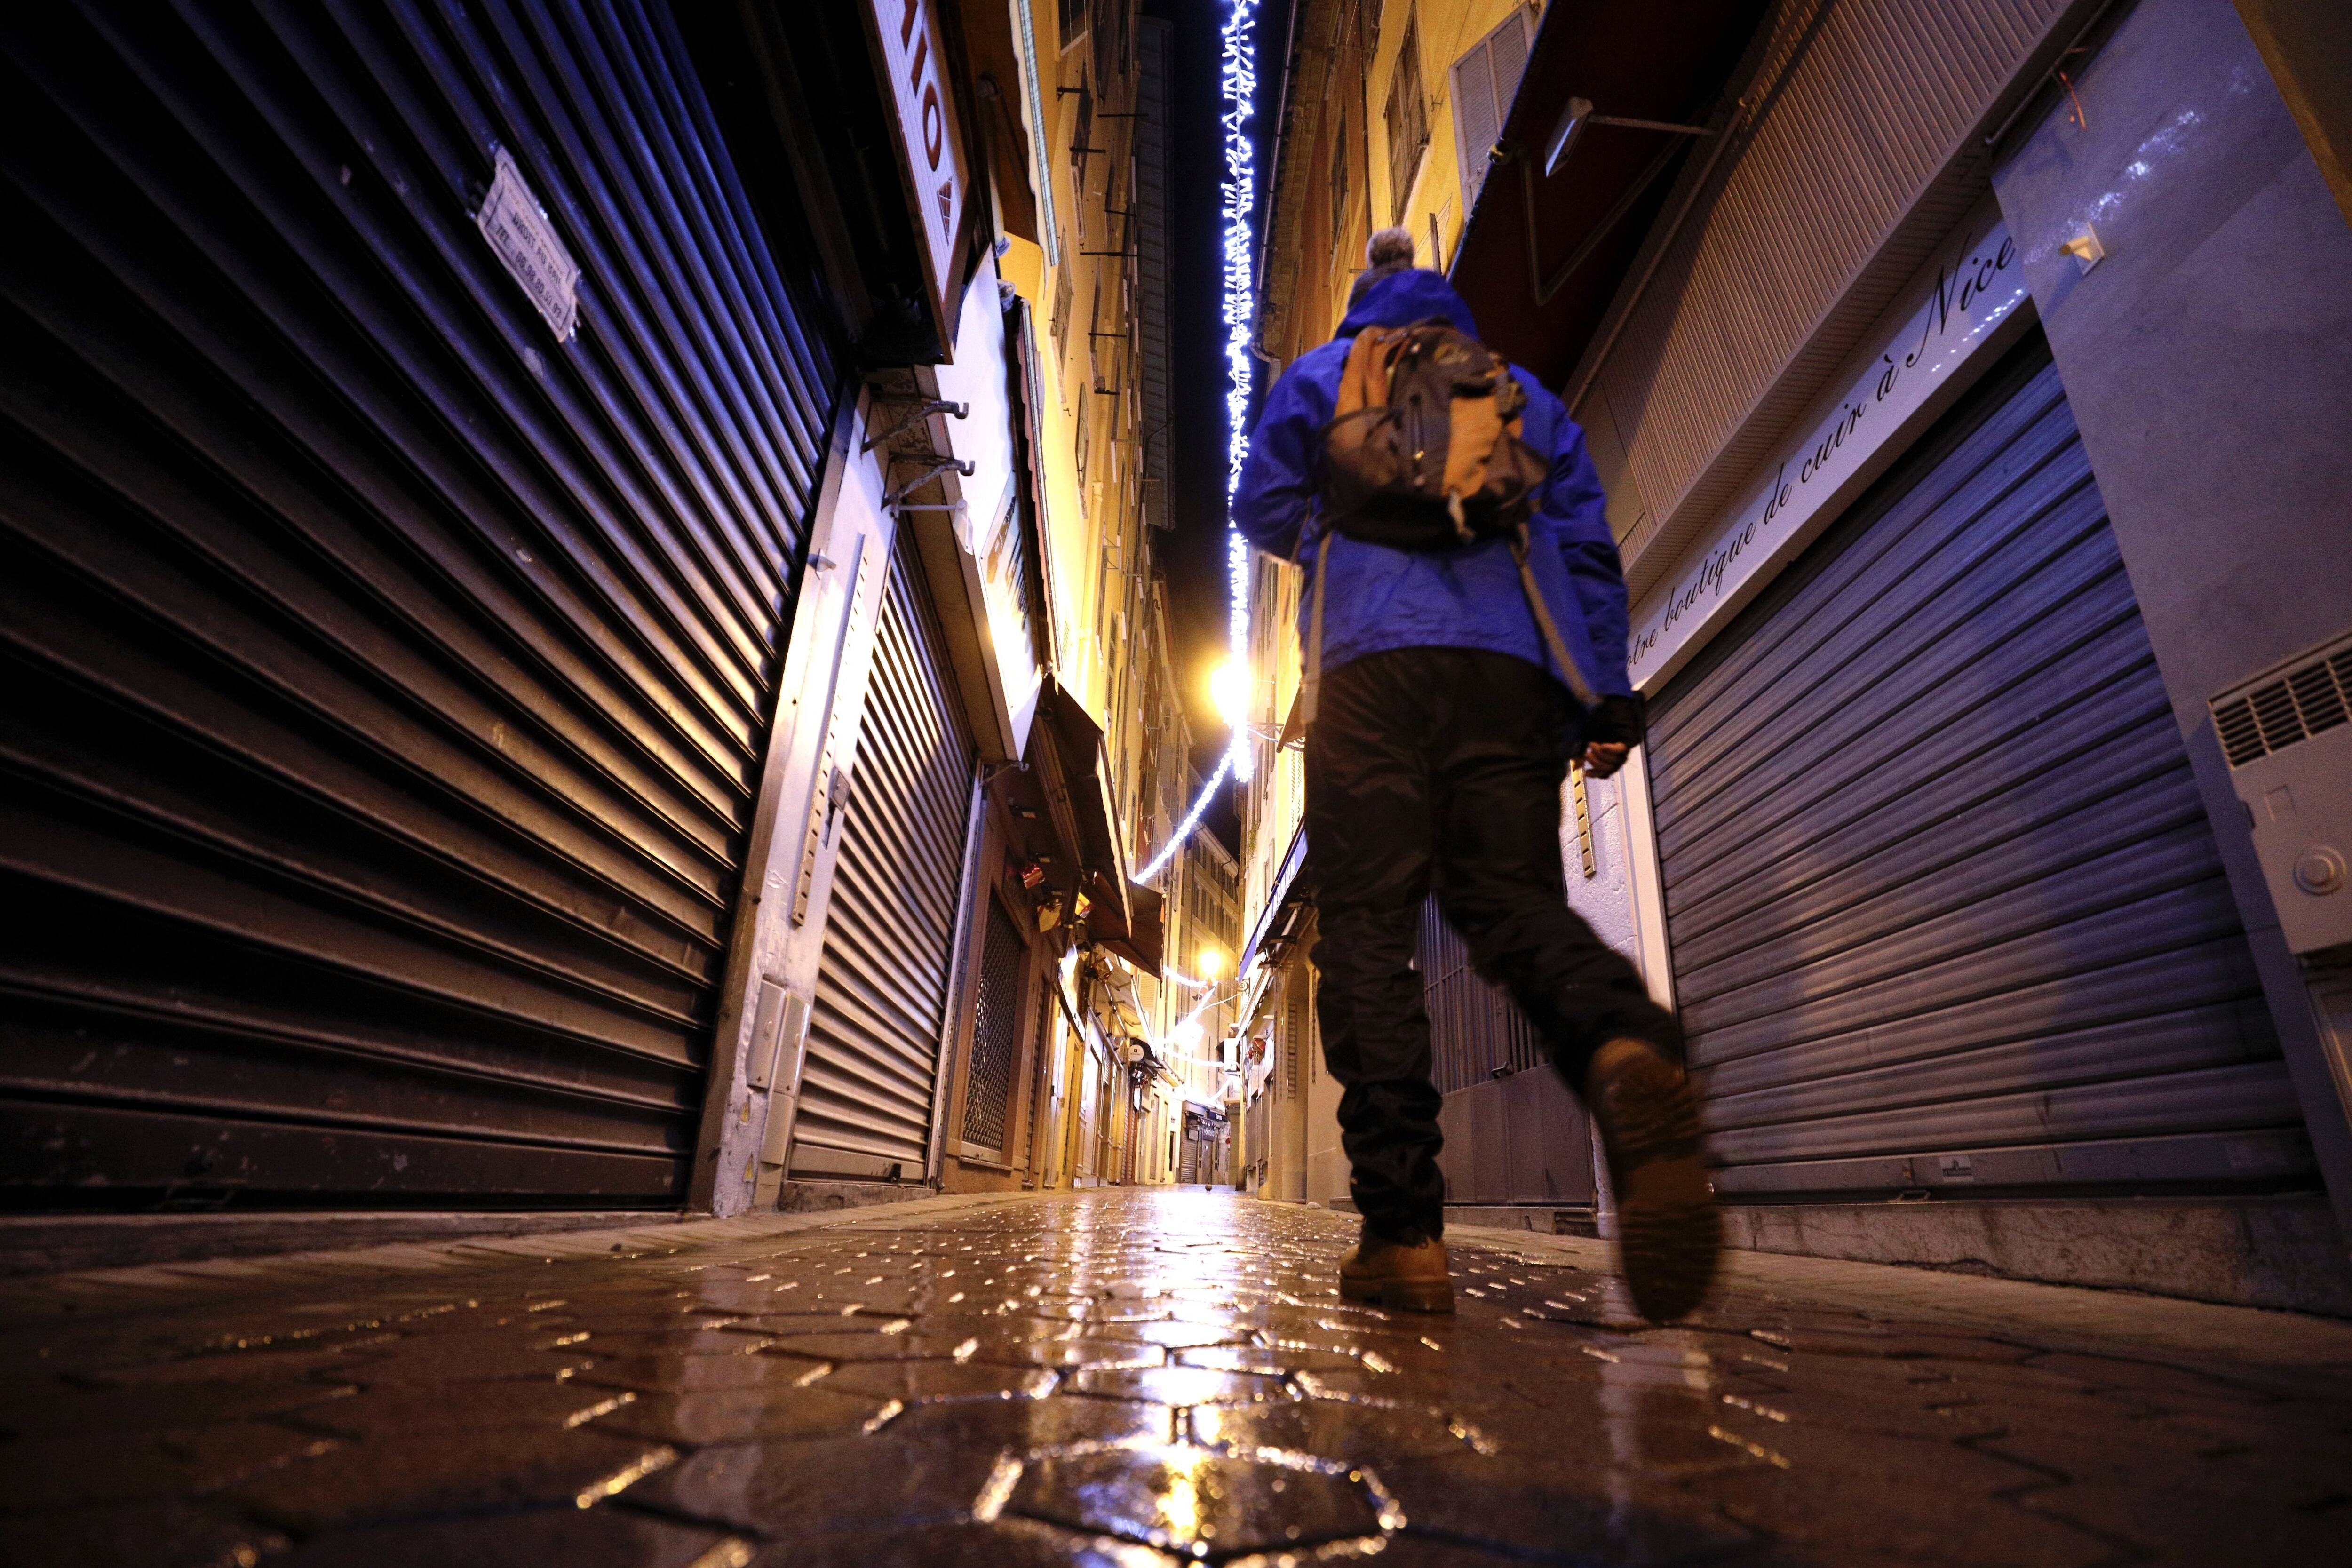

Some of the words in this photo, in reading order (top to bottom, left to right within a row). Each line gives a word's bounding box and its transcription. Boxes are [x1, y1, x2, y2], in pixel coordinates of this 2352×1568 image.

[512, 212, 536, 248] DROIT
[537, 246, 547, 264] AU
[1664, 522, 1756, 631] boutique
[1764, 462, 1792, 525] de
[1801, 403, 1867, 483] cuir
[1877, 353, 1900, 402] à
[1906, 231, 2016, 368] Nice
